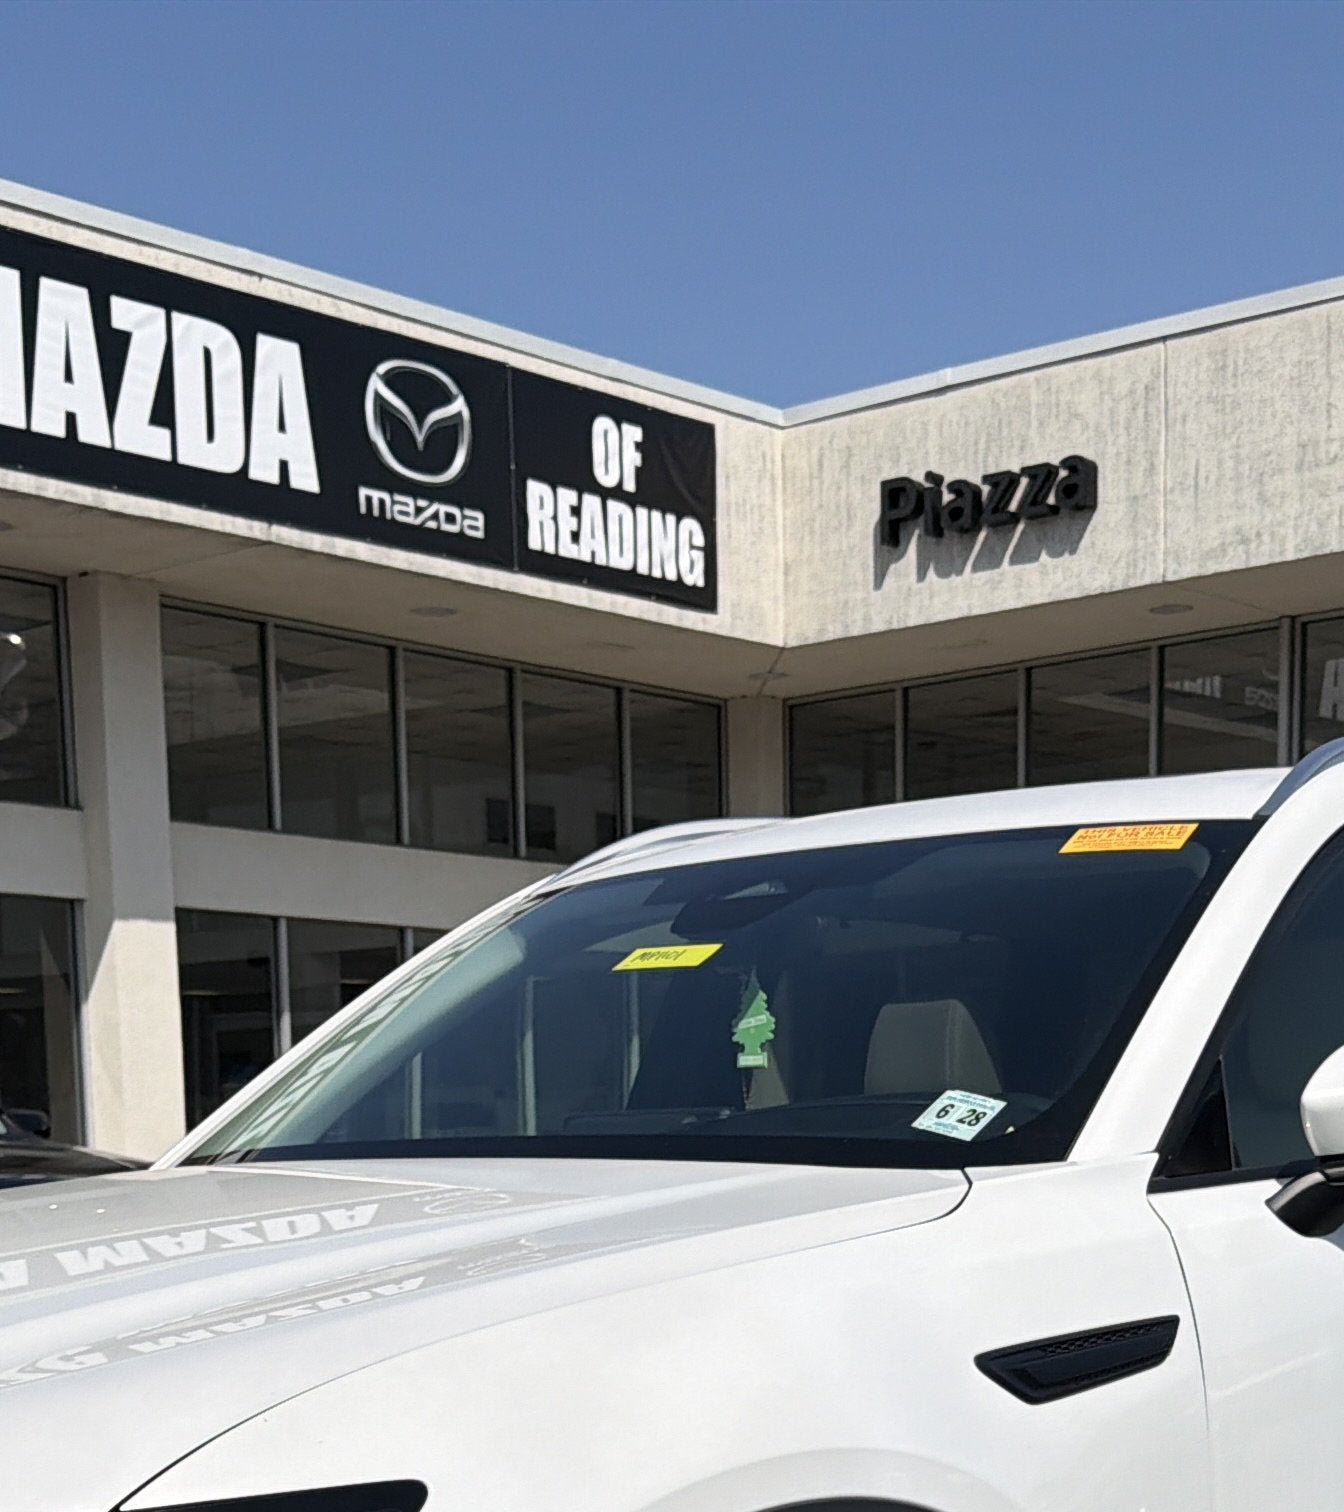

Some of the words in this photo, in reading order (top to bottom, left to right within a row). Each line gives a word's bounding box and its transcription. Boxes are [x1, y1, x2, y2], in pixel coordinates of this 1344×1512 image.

[591, 414, 643, 490] OF
[358, 485, 485, 540] mazda
[525, 478, 706, 588] READING
[879, 453, 1098, 548] Piazza
[935, 1103, 956, 1119] 6
[956, 1108, 988, 1127] 28
